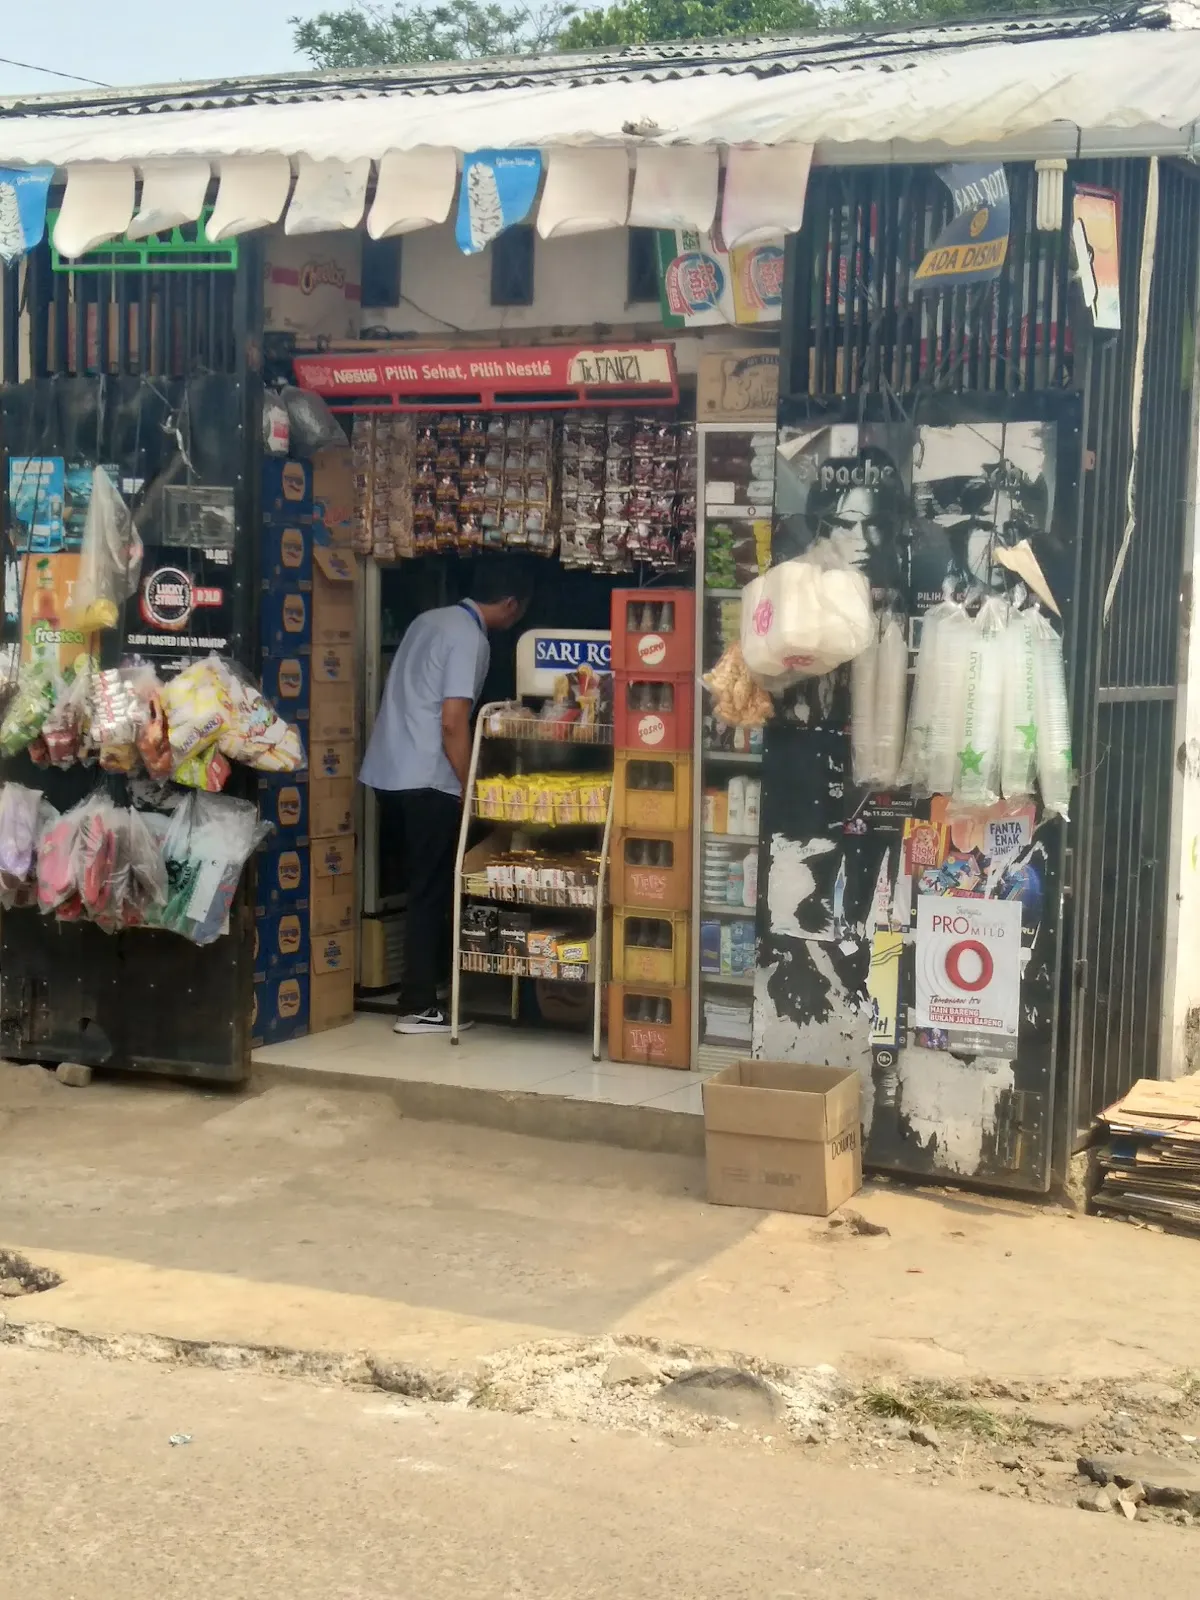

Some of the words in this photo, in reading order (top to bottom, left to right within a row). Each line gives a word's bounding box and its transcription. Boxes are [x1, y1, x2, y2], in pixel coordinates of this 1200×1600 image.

[954, 182, 984, 219] SARI
[980, 167, 1008, 207] ROTI
[925, 248, 959, 273] ADA
[384, 365, 418, 381] Pilih
[421, 363, 467, 381] Sehat,
[469, 361, 503, 378] Pilih
[506, 359, 552, 377] Nestlé
[156, 584, 184, 595] LUCKY
[917, 592, 948, 601] PILIHA
[155, 594, 185, 606] STRIKE
[128, 634, 146, 645] SLOW
[536, 641, 581, 666] SARI
[585, 643, 613, 665] RO
[968, 650, 978, 682] LAUT
[990, 821, 1022, 835] FANTA
[995, 834, 1020, 846] ENAK
[932, 914, 970, 935] PRO
[970, 927, 1005, 938] MILD
[930, 1005, 948, 1014] MAIN
[949, 1008, 979, 1017] BARENG
[930, 1013, 955, 1022] BUKAN
[955, 1016, 973, 1024] JAIM
[974, 1018, 1003, 1027] BARENG
